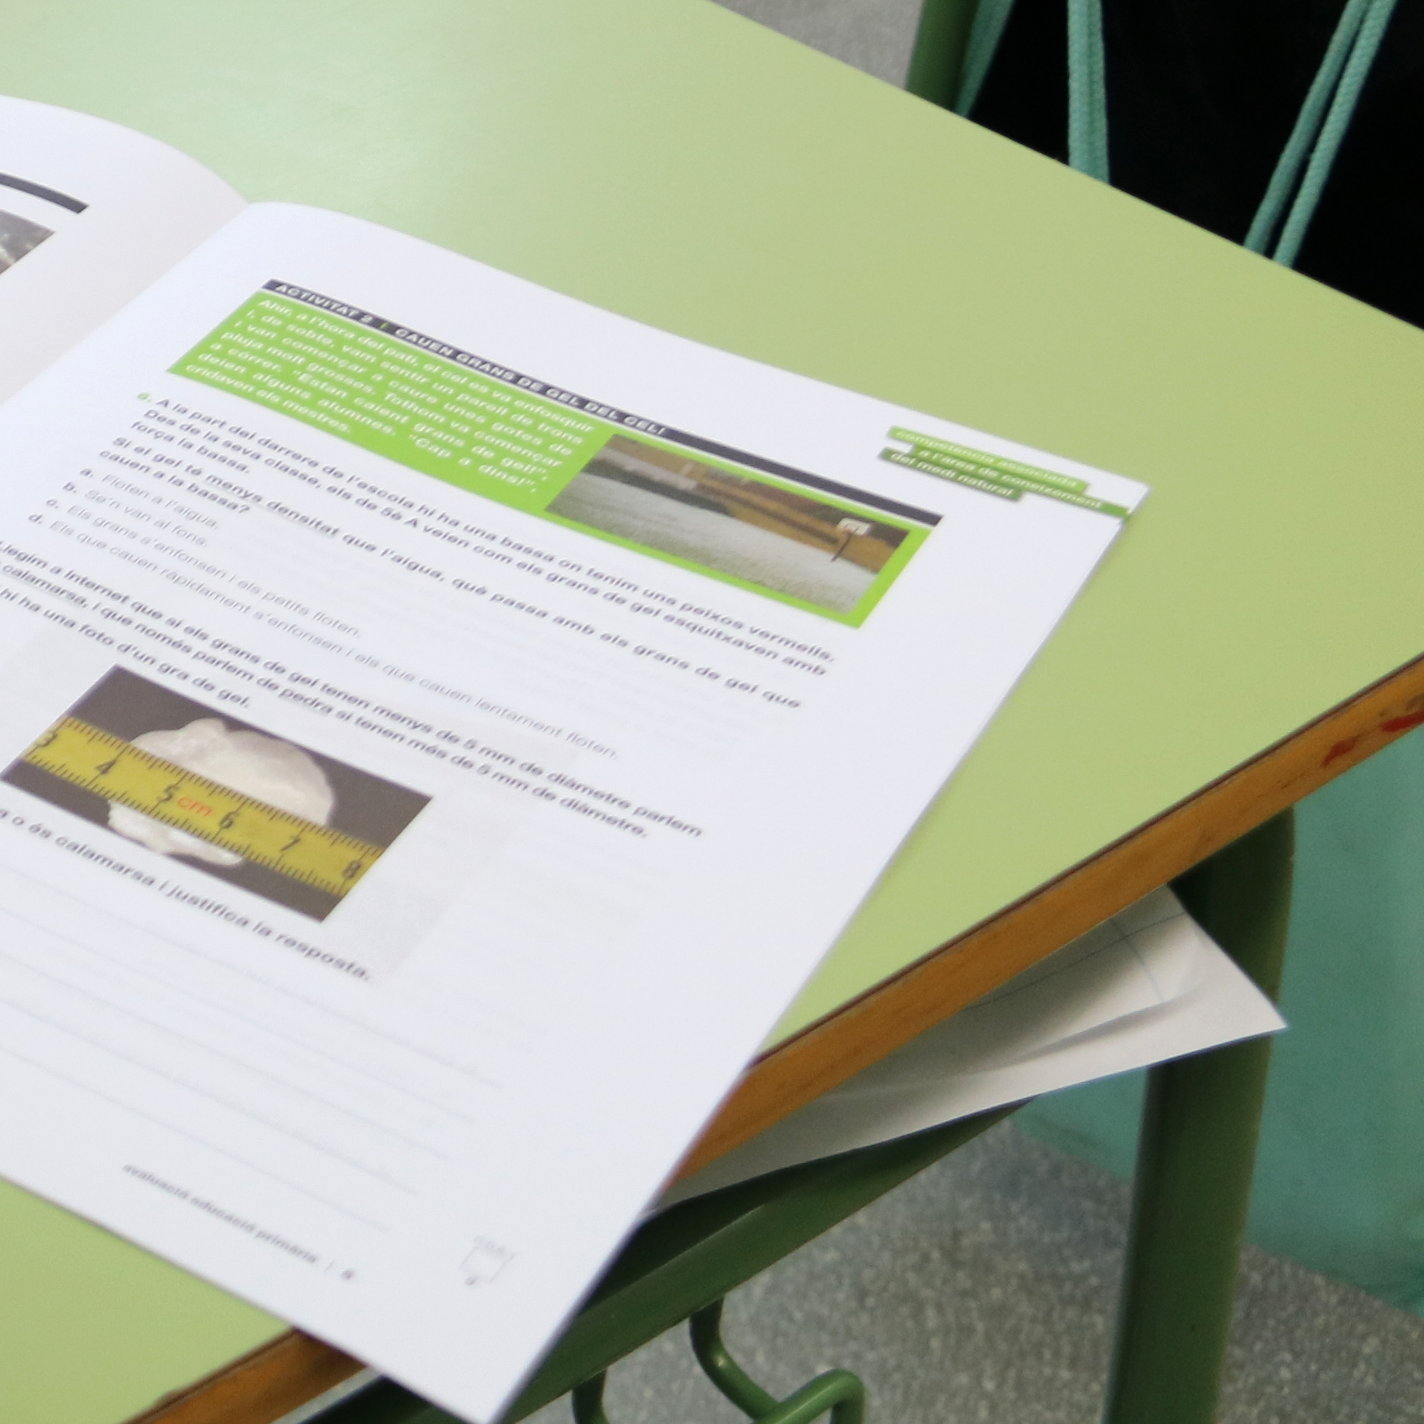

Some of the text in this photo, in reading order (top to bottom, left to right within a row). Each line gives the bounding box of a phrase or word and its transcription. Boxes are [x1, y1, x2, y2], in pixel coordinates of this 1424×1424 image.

[274, 283, 359, 317] ACTIVITAT
[394, 327, 454, 356] CAUEN
[455, 352, 515, 380] GRANS
[545, 387, 579, 406] GEL
[583, 401, 619, 419] DEL
[98, 449, 251, 514] cauen a la bassa?
[129, 420, 252, 474] força la bassa.
[112, 436, 132, 449] Si
[132, 445, 152, 456] el
[151, 453, 183, 468] gel
[205, 474, 263, 503] menys
[266, 500, 340, 536] densitat
[341, 533, 377, 552] que
[379, 547, 446, 582] l'aigua,
[488, 592, 548, 619] passa
[552, 615, 595, 635] amb
[599, 632, 629, 648] els
[632, 644, 689, 670] grans
[694, 666, 721, 680] de
[724, 677, 758, 694] gel
[761, 690, 801, 708] que
[142, 408, 177, 426] Des
[178, 423, 201, 435] de
[202, 430, 220, 443] la
[221, 439, 262, 461] seva
[263, 457, 322, 489] classe,
[325, 485, 353, 500] els
[354, 497, 378, 511] de
[404, 517, 419, 528] A
[422, 524, 470, 548] veien
[472, 544, 513, 564] com
[515, 560, 543, 575] els
[544, 571, 599, 595] grans
[601, 591, 627, 605] de
[629, 601, 662, 617] gel
[662, 613, 779, 660] esquitxaven
[781, 656, 826, 676] amb
[155, 398, 836, 662] A la part del darrere de l'escola hi ha una bassa on tenim uns peixos vermells.
[17, 595, 41, 613] ha
[42, 608, 77, 629] una
[77, 623, 115, 646] foto
[116, 643, 156, 666] d'un
[156, 662, 190, 681] gra
[191, 677, 216, 692] de
[216, 688, 252, 706] gel.
[95, 759, 116, 775] 4
[157, 785, 178, 804] 5
[176, 794, 215, 818] cm
[218, 811, 239, 829] 6
[280, 836, 301, 852] 7
[10, 815, 25, 826] o
[54, 835, 156, 886] calamarsa
[165, 885, 250, 928] justifica
[251, 920, 273, 937] la
[274, 933, 372, 981] resposta.
